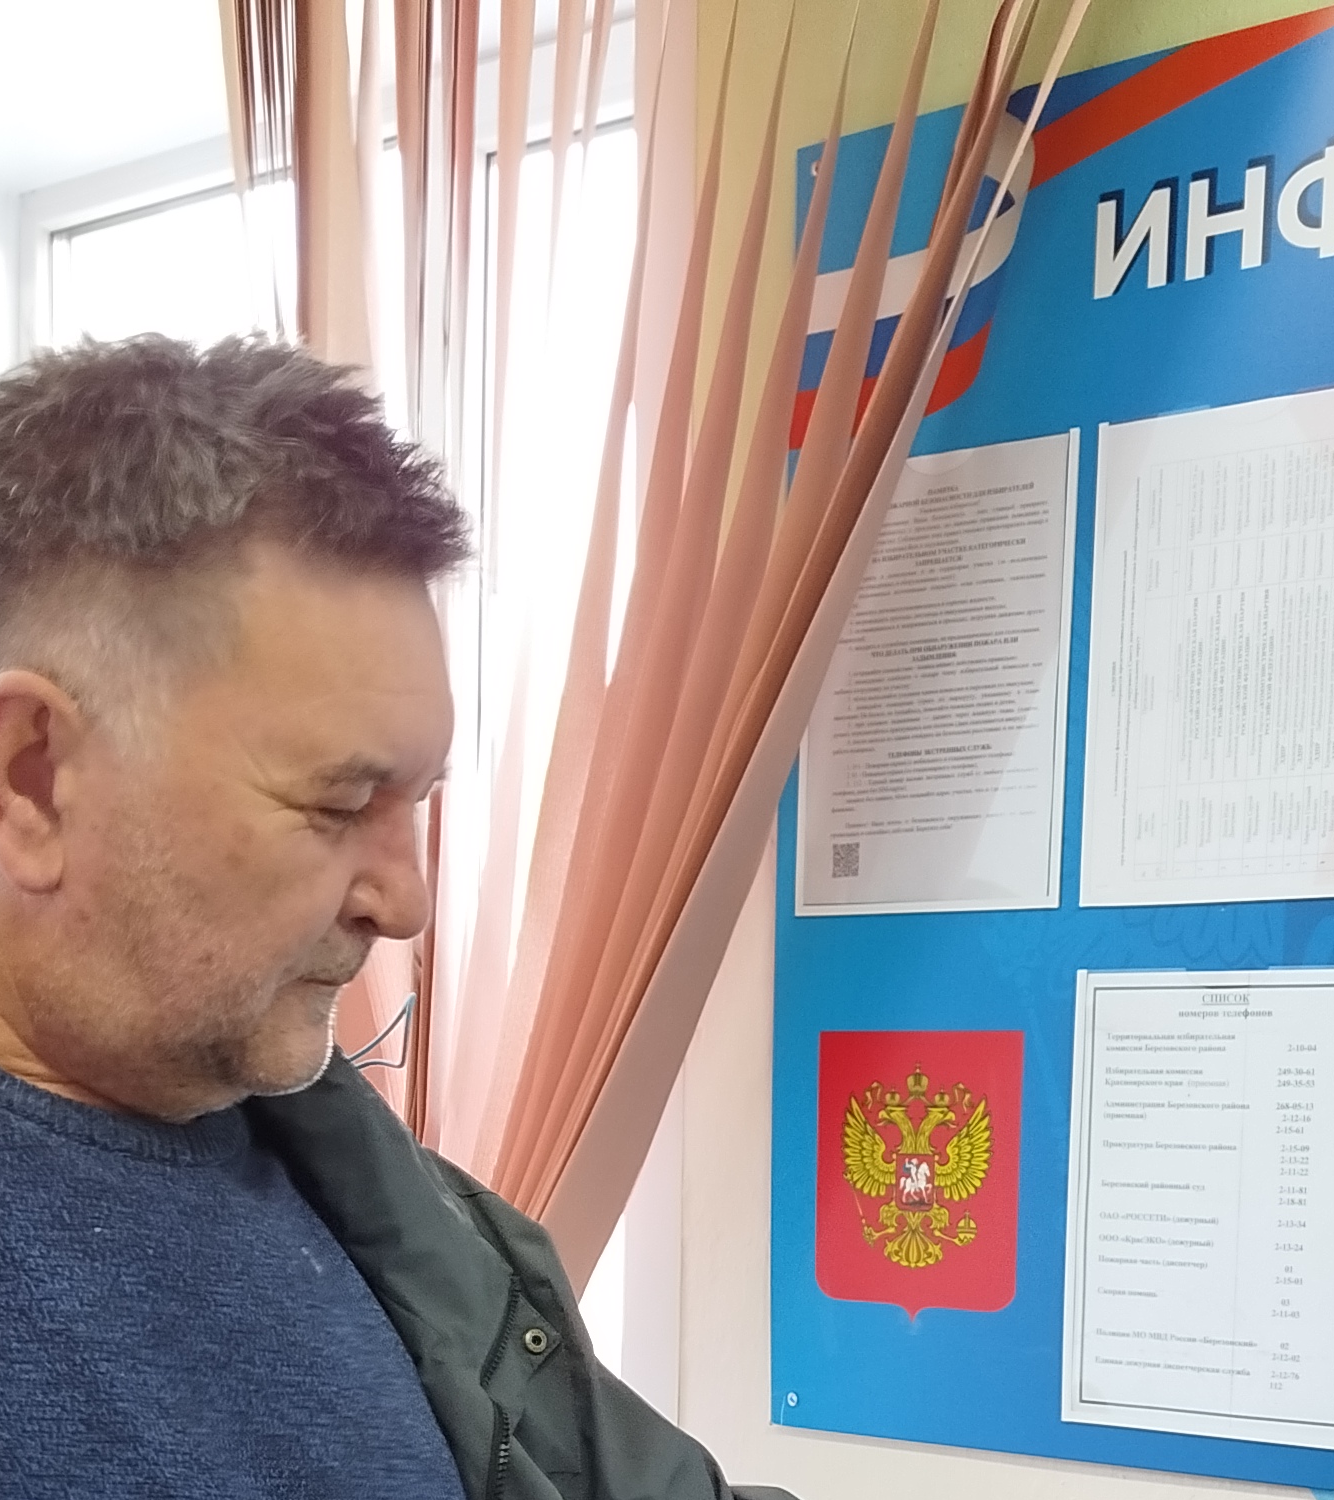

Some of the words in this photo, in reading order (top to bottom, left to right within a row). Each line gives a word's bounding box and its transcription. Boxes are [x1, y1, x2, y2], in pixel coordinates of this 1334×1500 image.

[1287, 1043, 1317, 1052] 2-10-04
[1277, 1067, 1315, 1076] 249-30-61
[1276, 1078, 1315, 1088] 249-35-53
[1275, 1101, 1314, 1111] 268-05-13
[1281, 1113, 1311, 1123] 2-12-16
[1275, 1125, 1304, 1135] 2-15-61
[1281, 1143, 1310, 1153] 2-15-09
[1279, 1154, 1309, 1166] 2-13-22
[1279, 1166, 1309, 1177] 2-11-22
[1279, 1185, 1307, 1195] 2-11-81
[1278, 1196, 1306, 1206] 2-18-81
[1277, 1218, 1306, 1229] 2-13-34
[1274, 1242, 1304, 1252] 2-13-24
[1283, 1264, 1293, 1274] 01
[1275, 1275, 1303, 1286] 2-15-01
[1280, 1297, 1290, 1307] 03
[1271, 1308, 1300, 1319] 2-11-03
[1278, 1341, 1289, 1351] 02
[1271, 1352, 1301, 1363] 2-12-02
[1270, 1369, 1300, 1381] 2-12-76
[1268, 1380, 1283, 1391] 112
